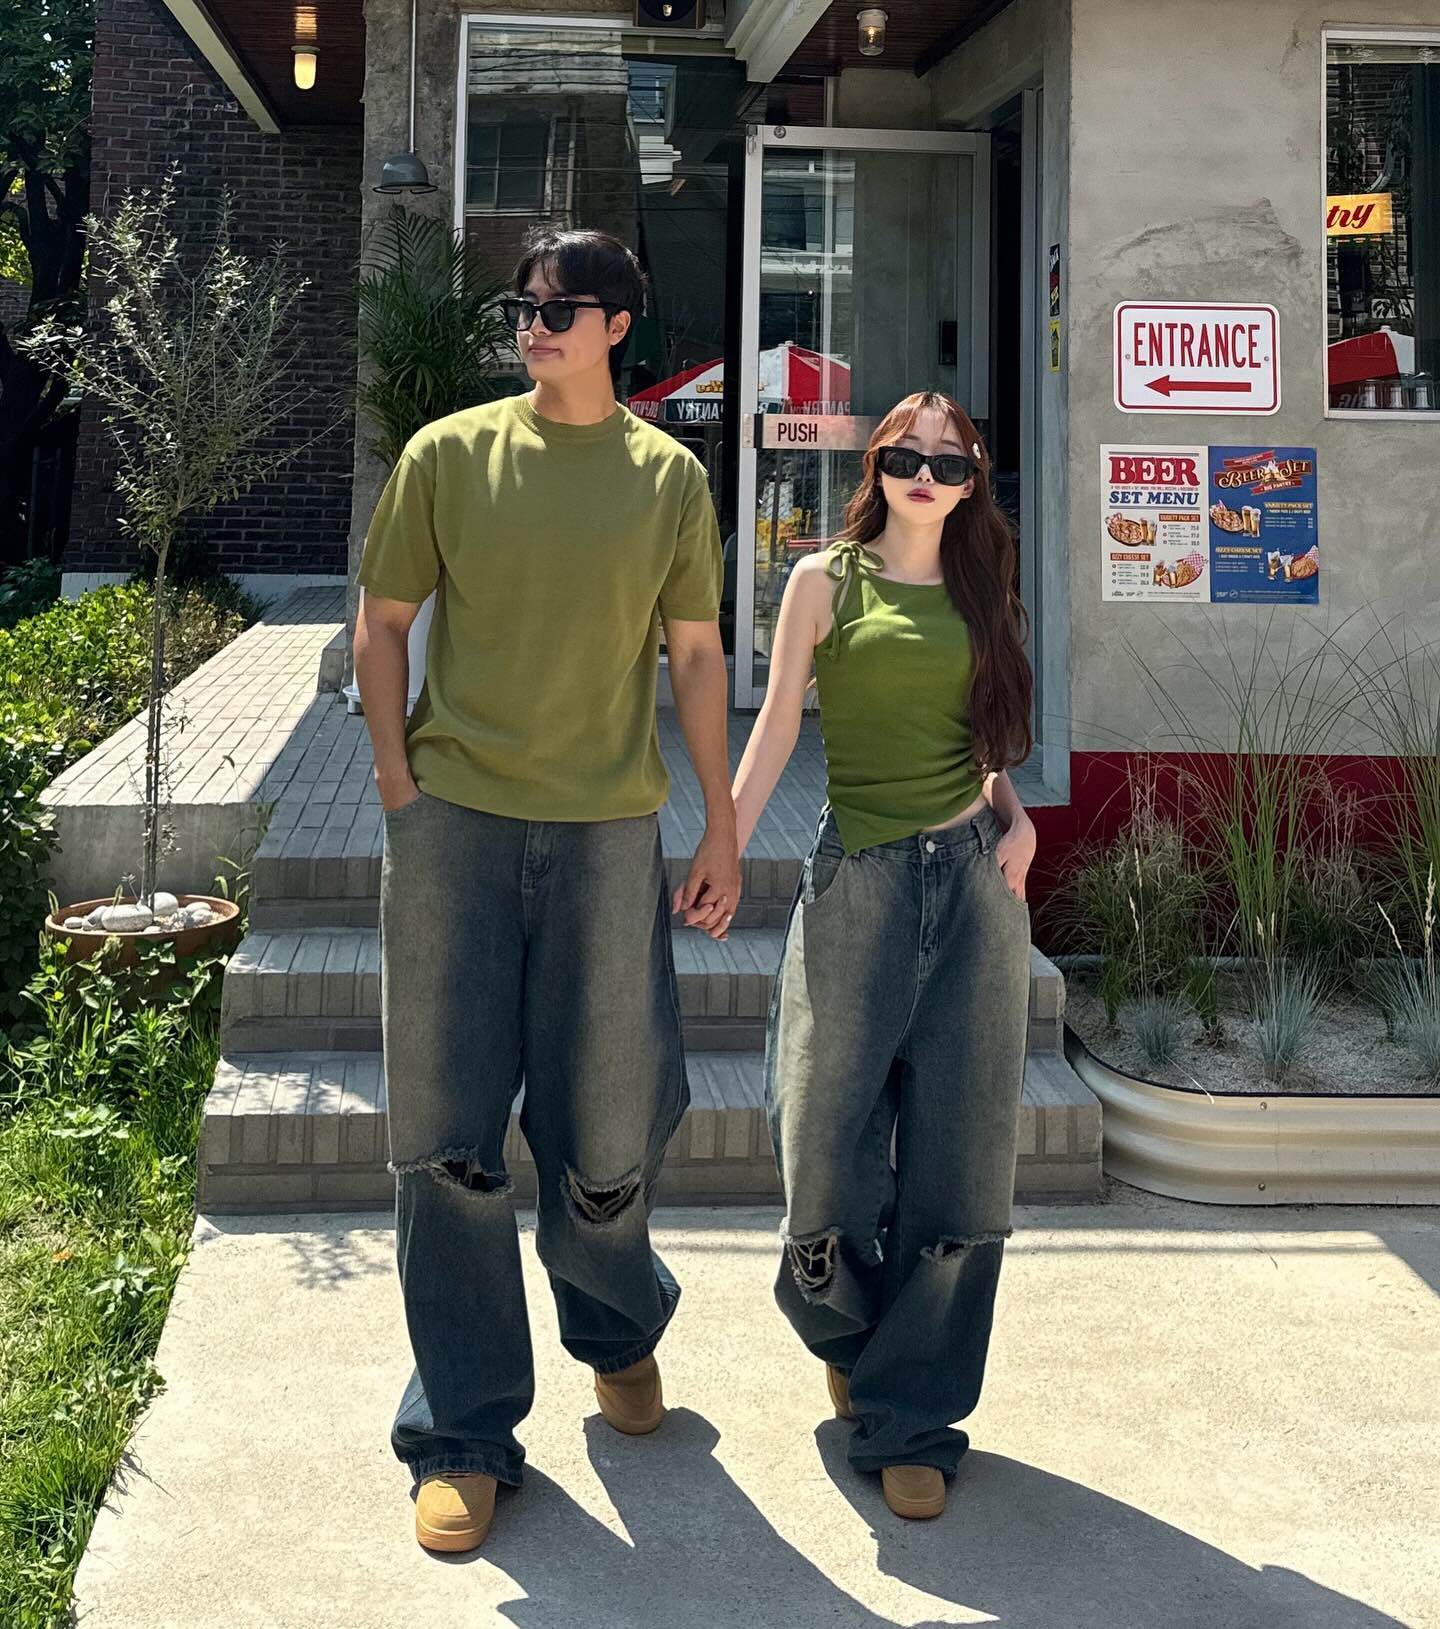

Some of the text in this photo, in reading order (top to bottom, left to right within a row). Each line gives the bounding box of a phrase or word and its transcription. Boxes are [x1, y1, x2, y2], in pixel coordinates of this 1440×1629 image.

[1134, 322, 1261, 368] ENTRANCE
[778, 423, 818, 443] PUSH
[1109, 457, 1200, 486] BEER
[1109, 491, 1199, 505] SET MENU
